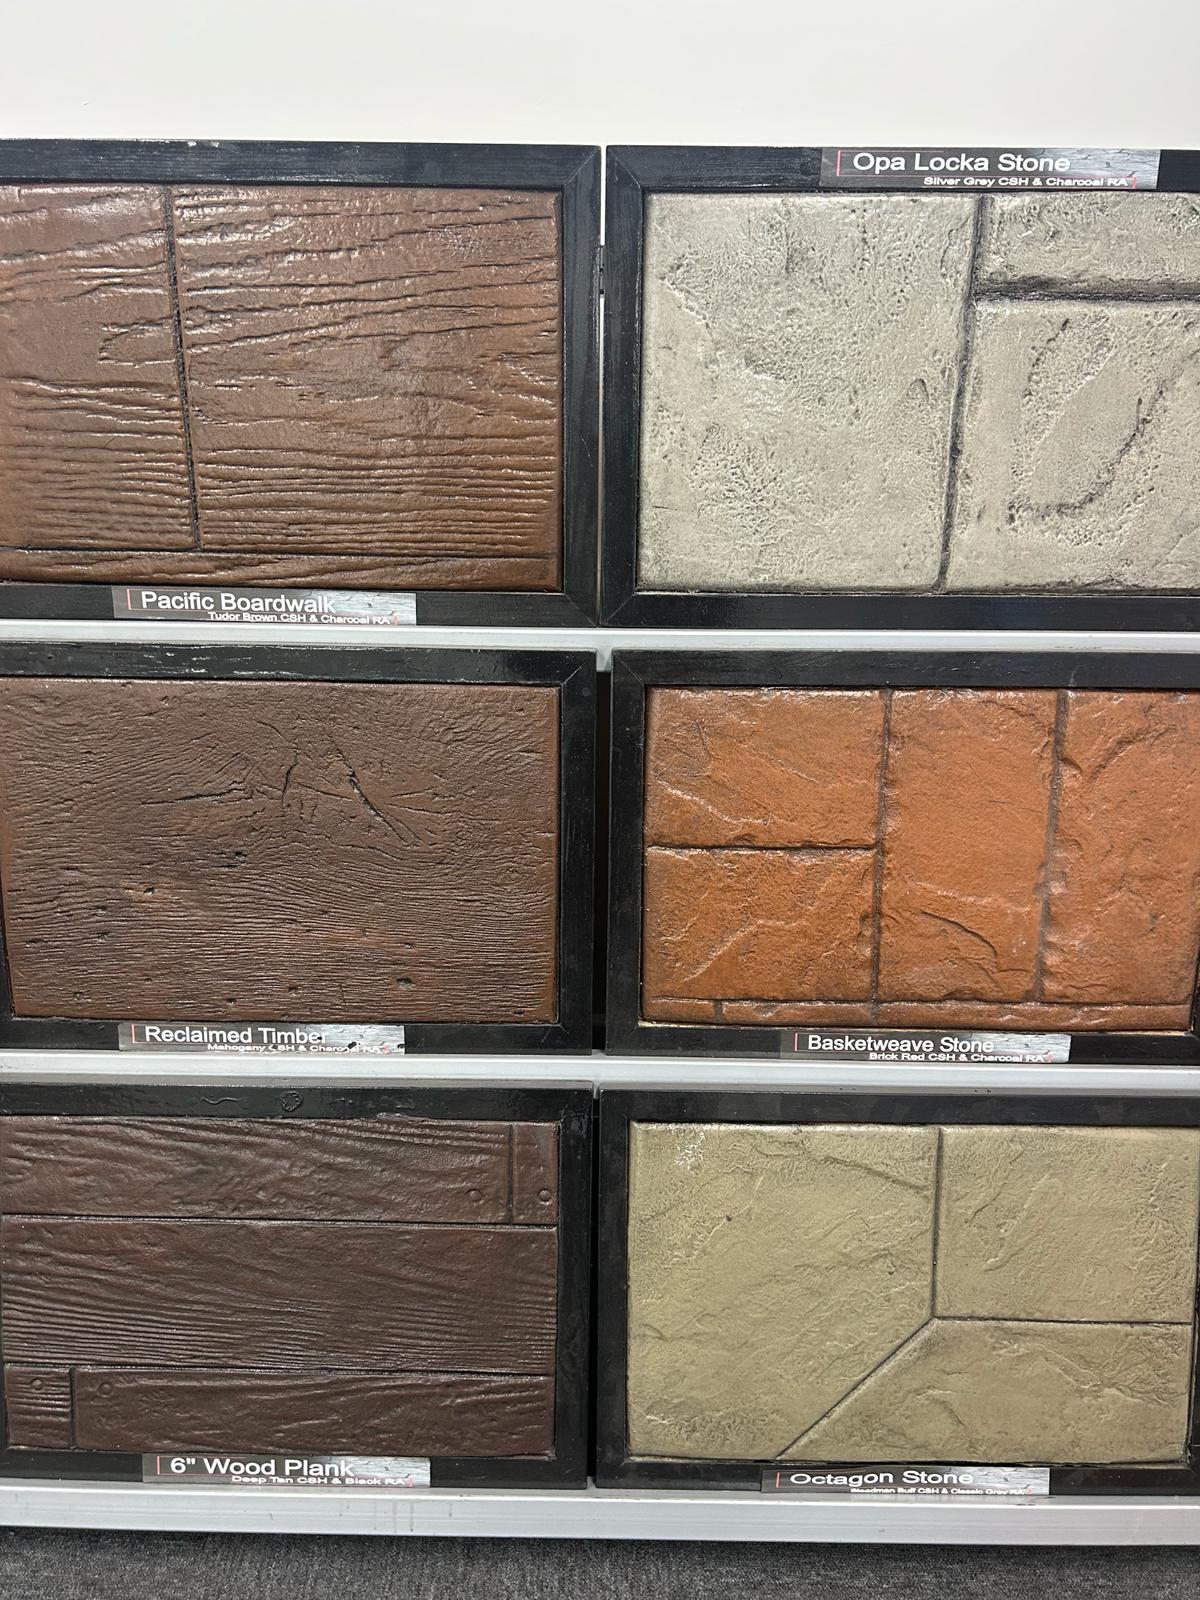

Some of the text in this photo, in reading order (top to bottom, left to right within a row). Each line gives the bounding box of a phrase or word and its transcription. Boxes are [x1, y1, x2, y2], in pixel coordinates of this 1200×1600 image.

[853, 152, 1071, 174] Opa Locka Stone
[923, 176, 1128, 188] Silver Grey CSH & Charcoal RA
[141, 590, 336, 613] Pacific Boardwalk
[207, 611, 391, 625] Tudor Brown CSH & Charcoal RA
[145, 1025, 329, 1044] Reclaimed Timber
[808, 1034, 995, 1053] Basketweave Stone
[207, 1043, 266, 1051] Mahogany
[869, 1052, 1045, 1063] Brick Red CSH & Charcoal RA
[170, 1457, 354, 1477] 6" Wood Plank
[231, 1475, 406, 1486] Deep Tan CSH & Black RA
[790, 1470, 974, 1488] Octagon Stone
